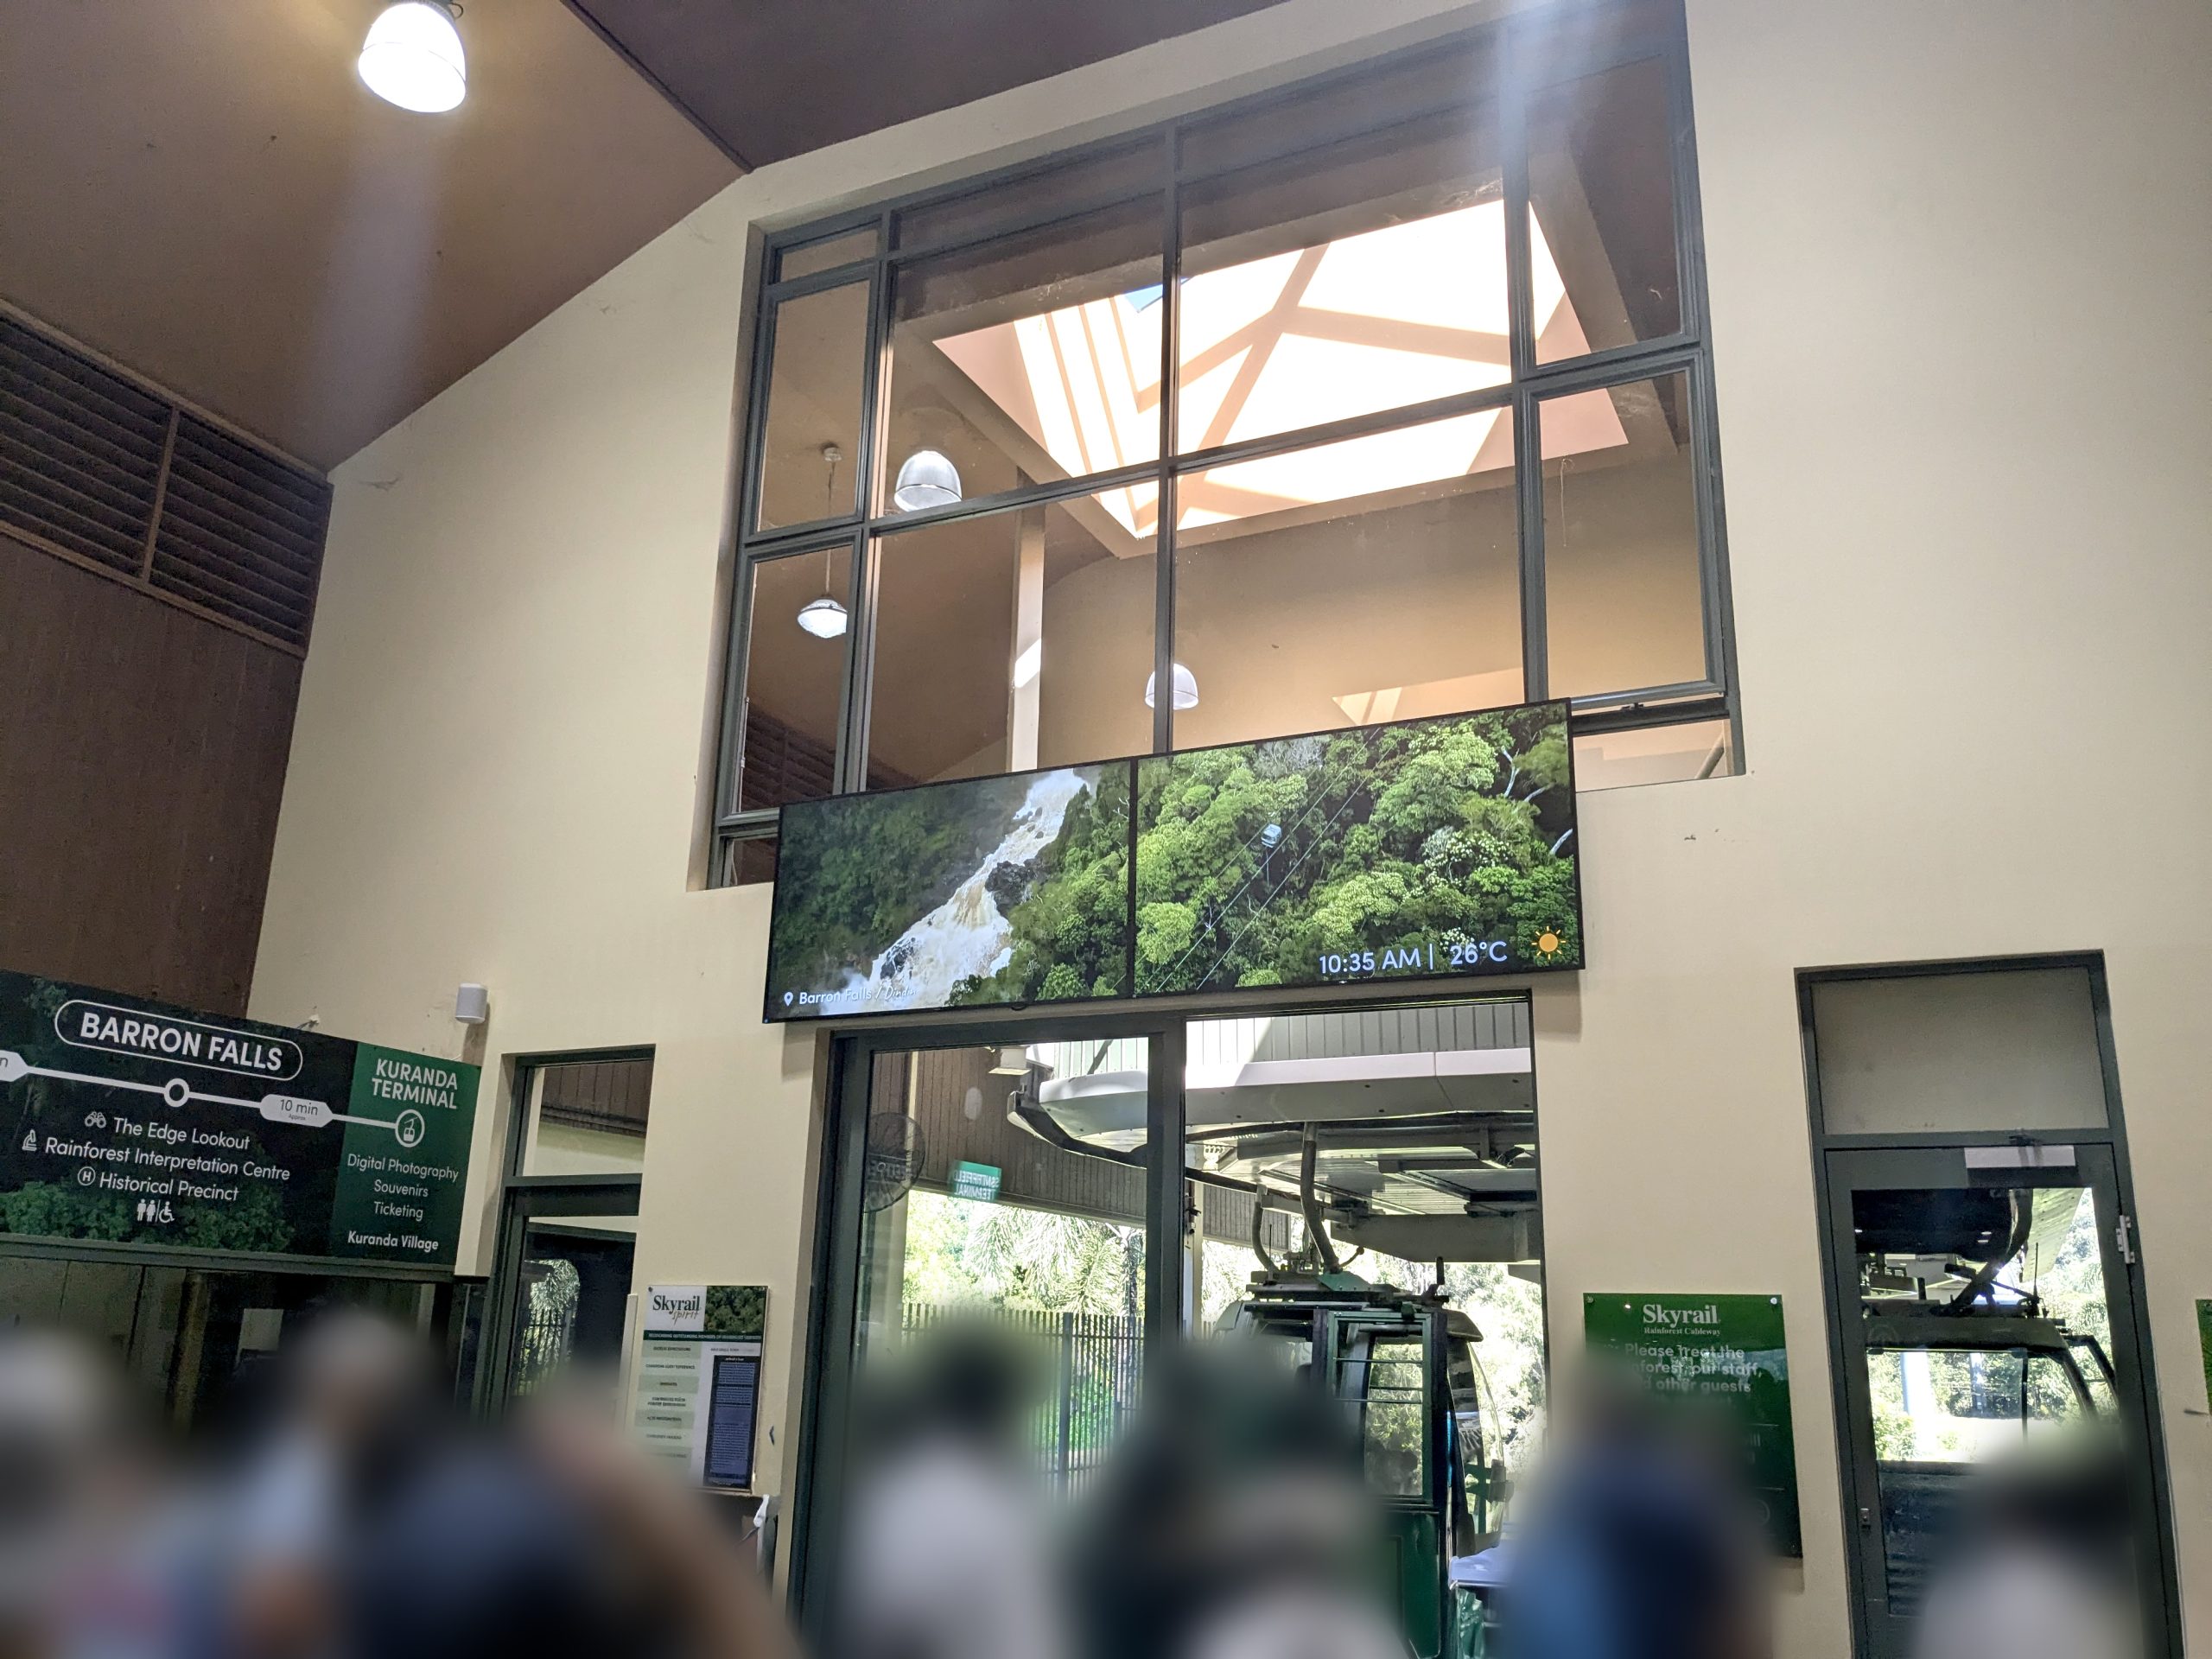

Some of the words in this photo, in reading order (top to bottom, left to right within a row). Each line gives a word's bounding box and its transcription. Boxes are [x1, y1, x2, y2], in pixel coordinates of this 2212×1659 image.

[1319, 951, 1376, 974] 10:35
[1382, 948, 1421, 969] AM
[1450, 941, 1508, 965] 26°C
[799, 991, 841, 1004] Barron
[845, 988, 872, 1001] Falls
[80, 1012, 201, 1057] BARRON
[208, 1036, 283, 1071] FALLS
[376, 1058, 458, 1090] KURANDA
[372, 1077, 457, 1109] TERMINAL
[281, 1099, 293, 1111] 10
[296, 1103, 318, 1116] min
[114, 1117, 143, 1135] The
[148, 1122, 187, 1145] Edge
[192, 1128, 251, 1150] Lookout
[45, 1136, 130, 1162] Rainforest
[135, 1147, 238, 1174] Interpretation
[243, 1161, 290, 1180] Centre
[347, 1154, 386, 1172] Digital
[388, 1159, 459, 1183] Photography
[99, 1172, 174, 1195] Historical
[178, 1180, 239, 1201] Precinct
[374, 1179, 429, 1198] Souvenirs
[374, 1201, 423, 1222] Ticketing
[347, 1230, 398, 1247] Kuranda
[401, 1235, 439, 1253] Village
[652, 1294, 700, 1314] Skyrail
[672, 1311, 699, 1326] spirit
[1643, 1304, 1718, 1328] Skyrail
[1684, 1327, 1720, 1337] Cableway
[1624, 1343, 1674, 1357] Please
[1719, 1344, 1745, 1358] the
[1692, 1364, 1716, 1375] our
[1656, 1377, 1697, 1391] other
[1700, 1381, 1751, 1395] guests
